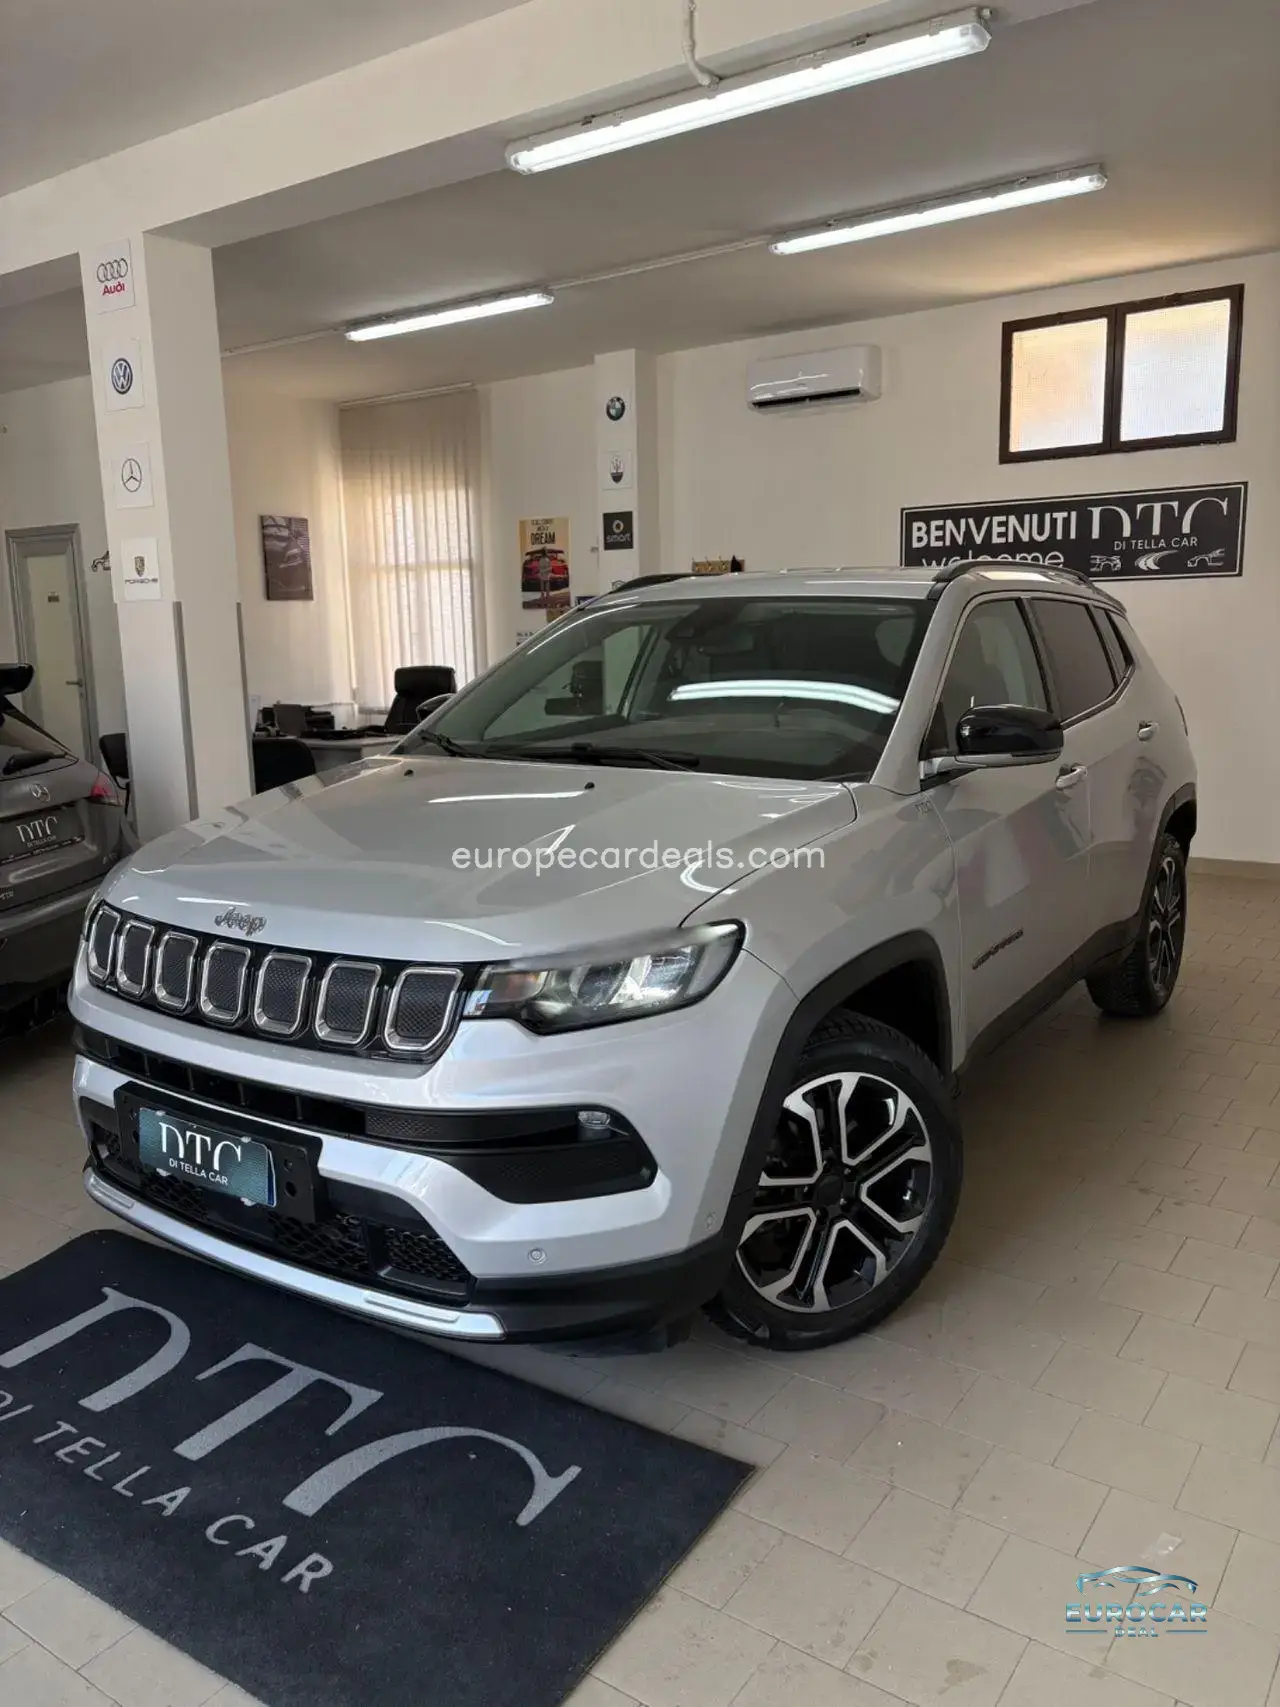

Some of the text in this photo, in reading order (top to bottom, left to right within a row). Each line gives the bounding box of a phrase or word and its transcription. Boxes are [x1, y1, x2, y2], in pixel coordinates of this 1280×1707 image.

[530, 531, 556, 545] DREAM
[912, 511, 1077, 549] BENVENUTI
[1114, 536, 1198, 551] DI TELLA CAR
[169, 1158, 228, 1186] DI TELLA CAR
[33, 1421, 193, 1517] TELLA
[204, 1514, 334, 1593] CAR
